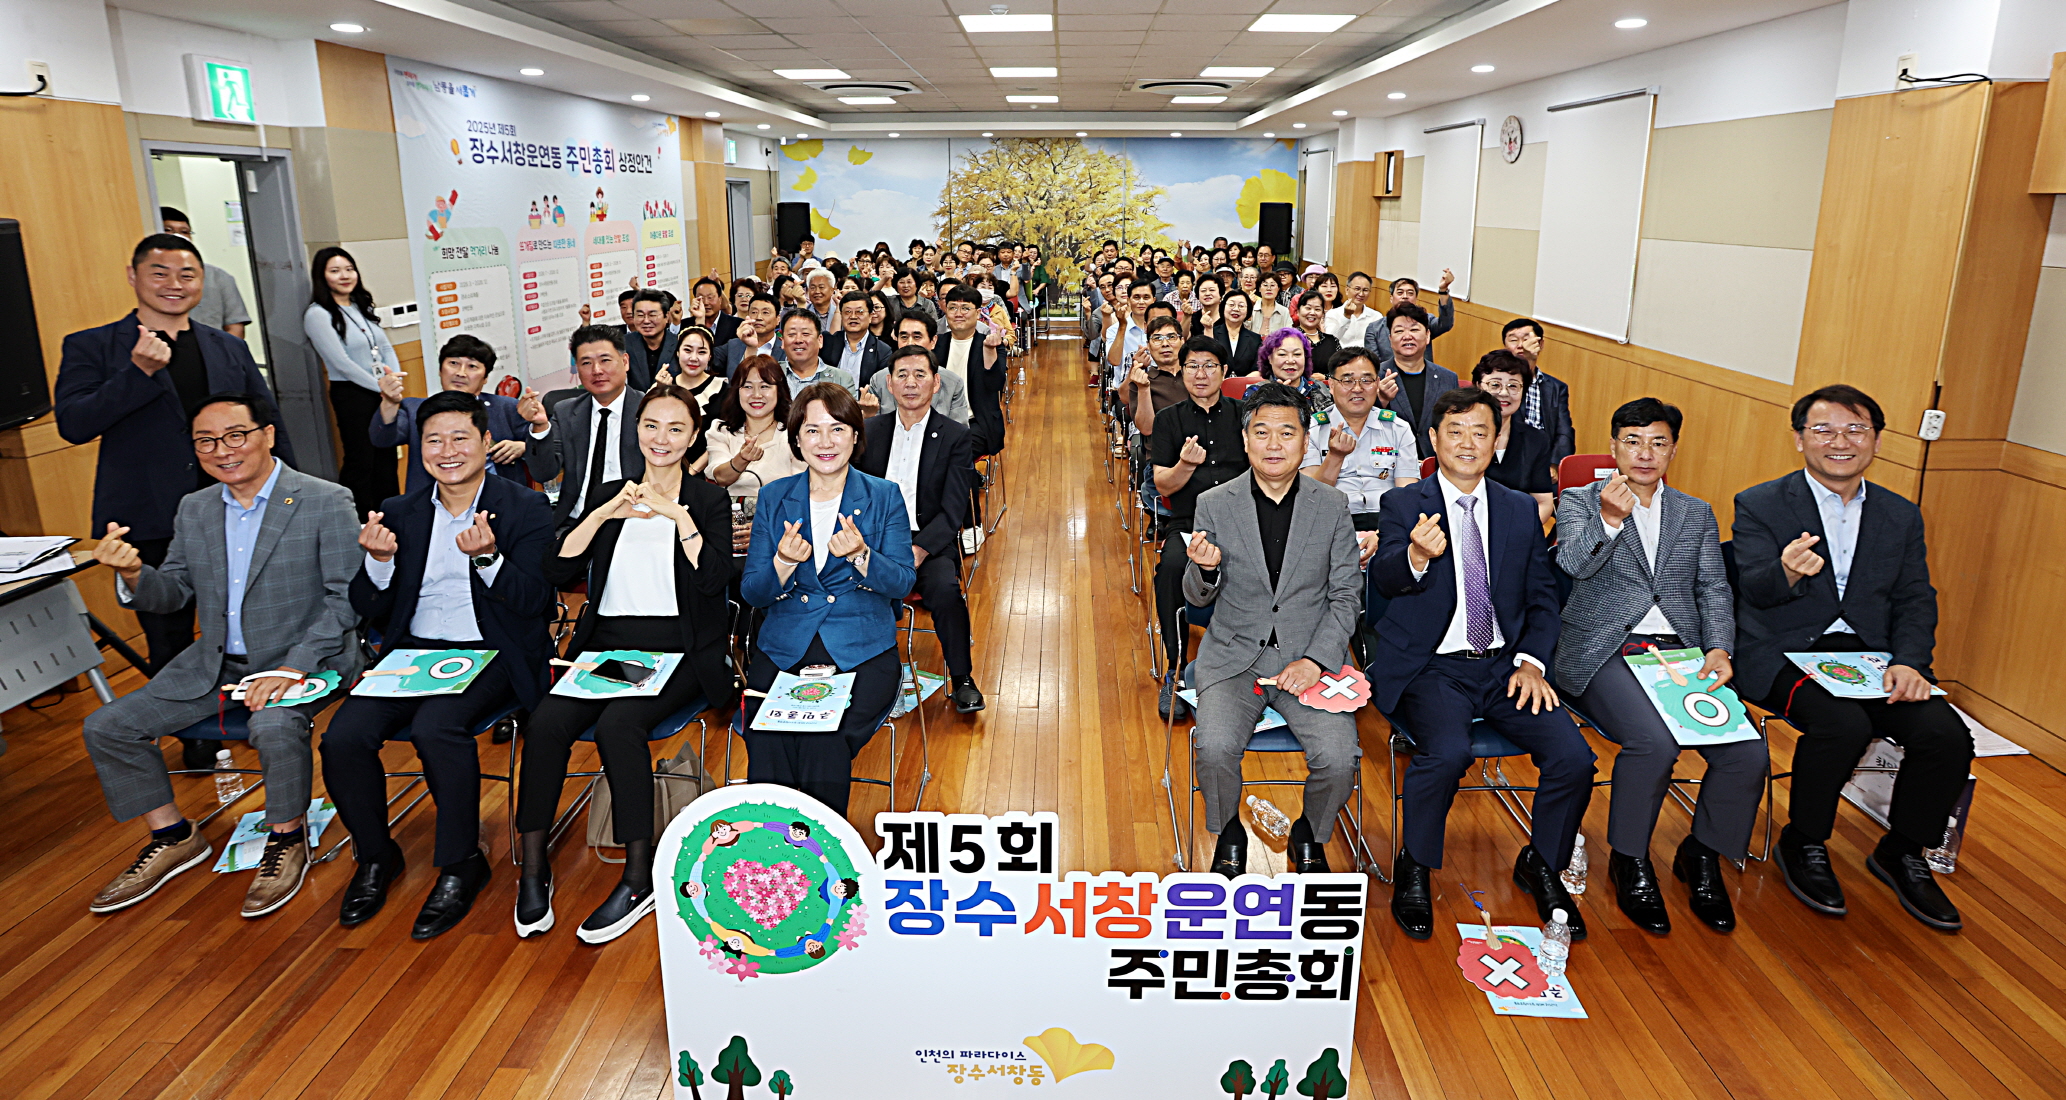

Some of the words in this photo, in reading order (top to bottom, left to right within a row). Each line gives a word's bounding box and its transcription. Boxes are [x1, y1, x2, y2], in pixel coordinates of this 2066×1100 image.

[466, 119, 496, 135] 2025년
[497, 123, 517, 137] 제5회
[469, 137, 562, 169] 장수서창운연동
[566, 145, 615, 174] 주민총회
[619, 151, 653, 174] 상정안건
[441, 246, 454, 260] 희망
[456, 246, 469, 259] 전달
[488, 244, 499, 256] 나눔
[883, 821, 1053, 874] 제5회
[885, 879, 1363, 941] 장수서창운연동
[1107, 946, 1355, 1001] 주민총회
[915, 1049, 955, 1063] 인천의
[960, 1050, 1027, 1061] 파라다이스
[946, 1064, 1045, 1086] 장수서창동
